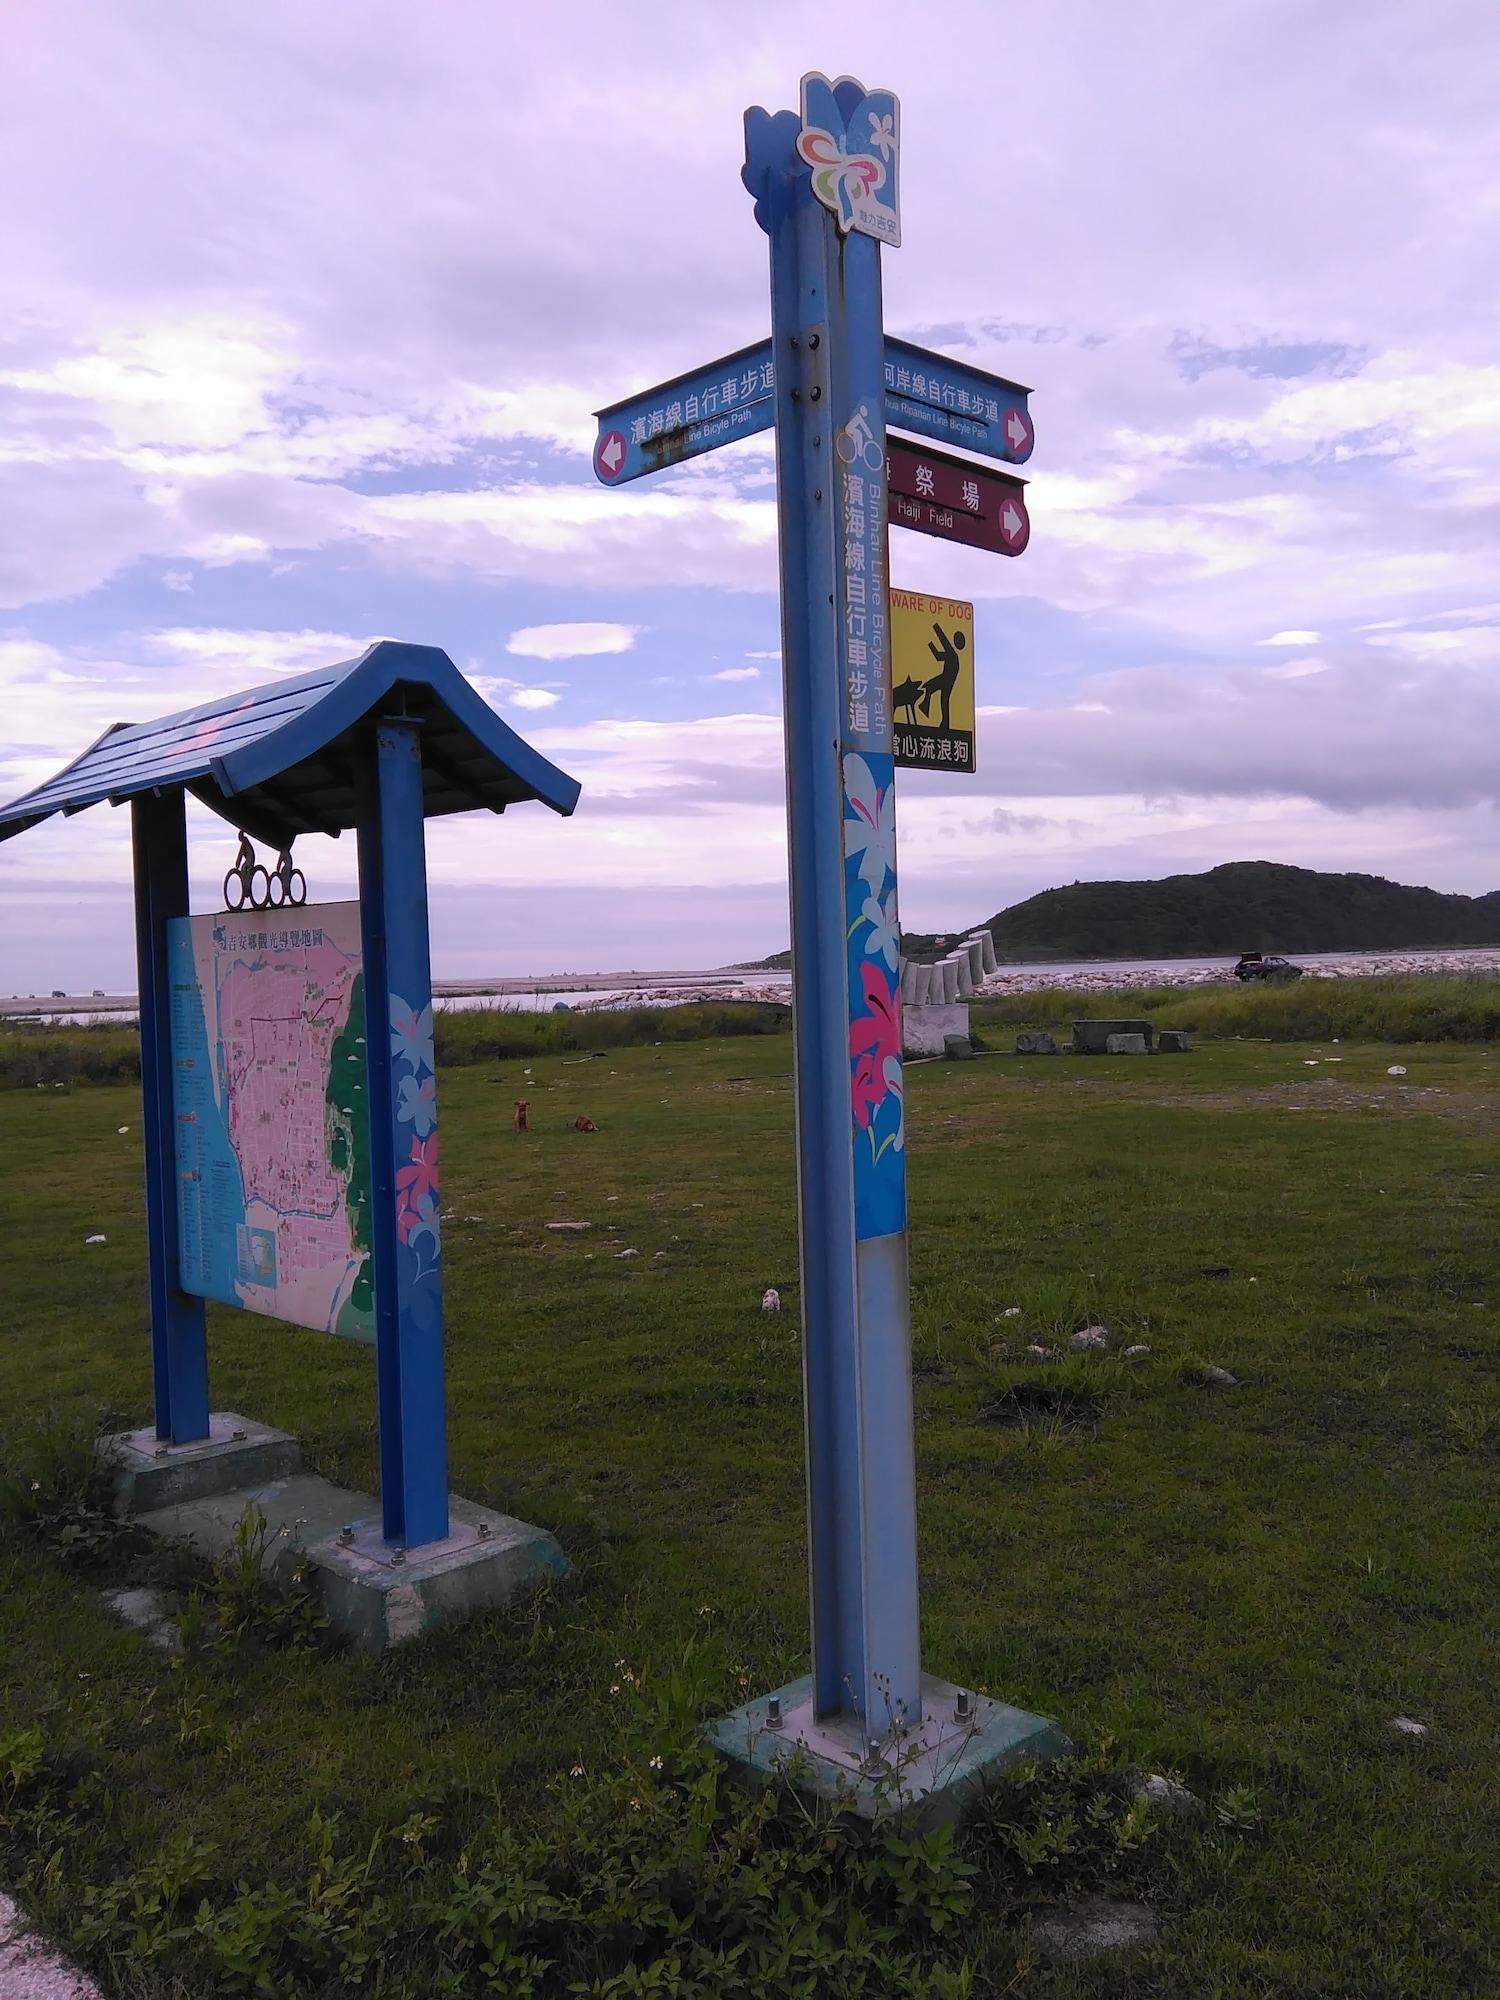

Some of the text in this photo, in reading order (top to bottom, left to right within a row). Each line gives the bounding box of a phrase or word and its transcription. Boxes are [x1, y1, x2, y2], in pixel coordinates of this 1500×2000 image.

[630, 361, 775, 445] 濱海線自行車步道
[731, 409, 752, 426] Path
[901, 402, 931, 422] Riparian
[932, 413, 948, 427] Line
[898, 500, 953, 529] Haiji Field
[844, 472, 870, 733] 濱海線自行車步道
[868, 483, 887, 735] Binhai Line Bicycle Path
[929, 600, 943, 615] OF
[948, 604, 972, 621] DOG
